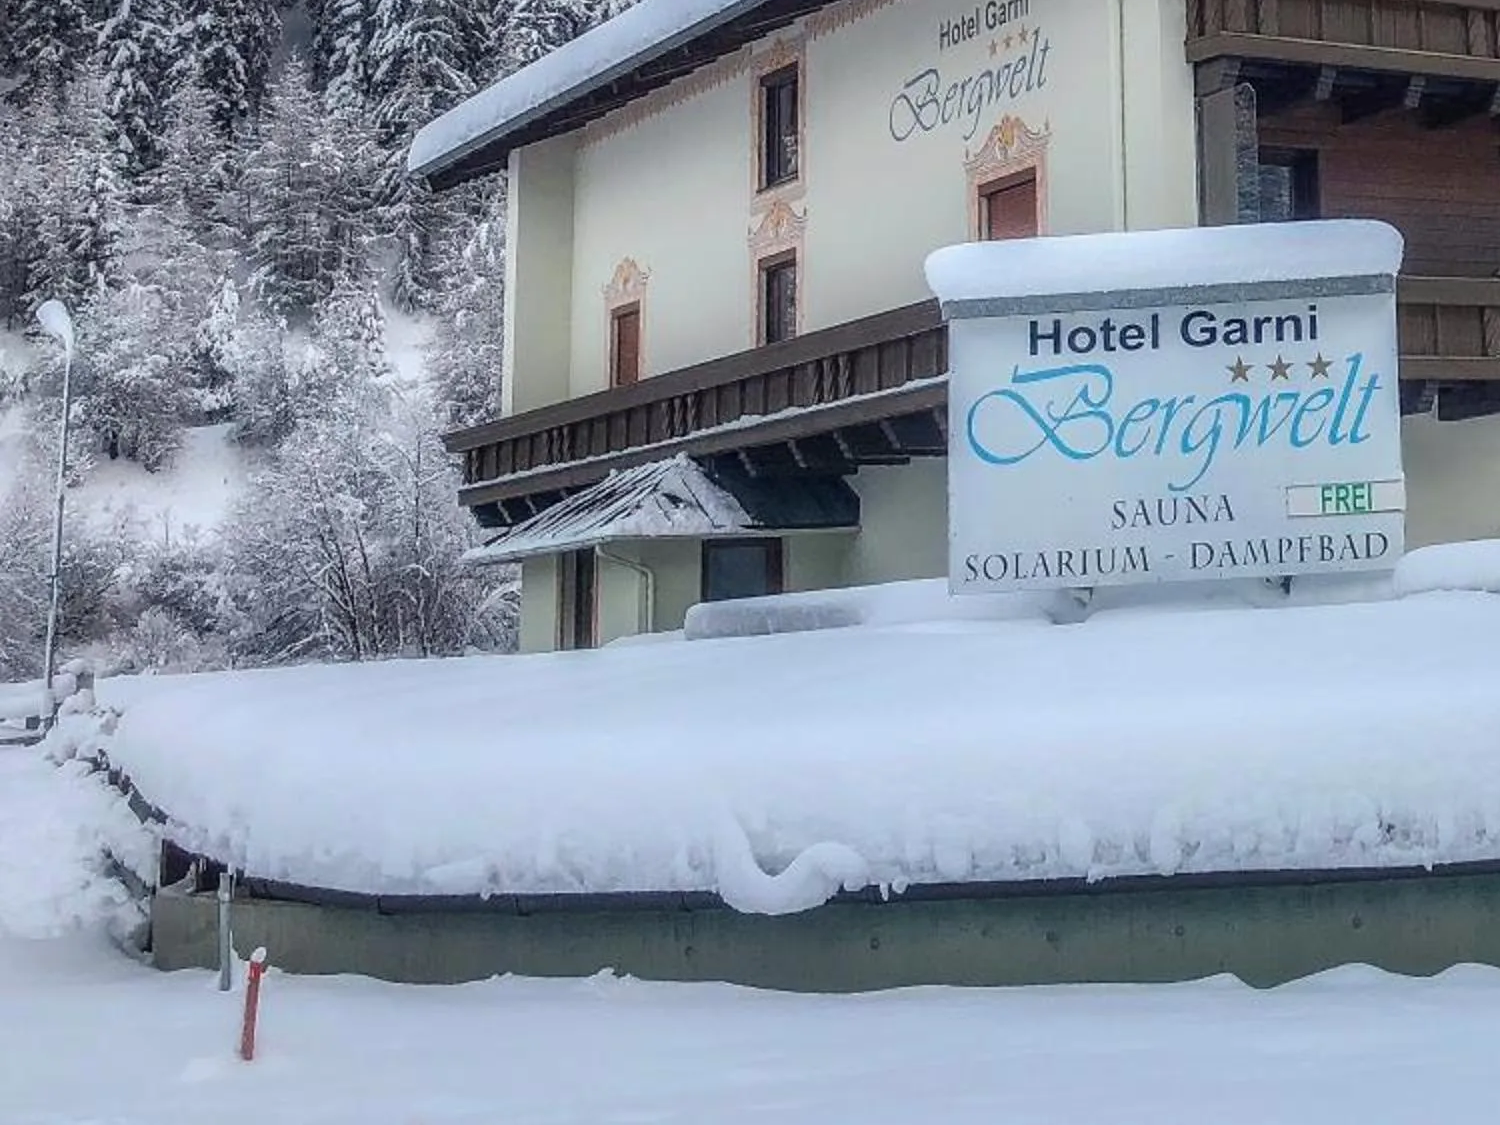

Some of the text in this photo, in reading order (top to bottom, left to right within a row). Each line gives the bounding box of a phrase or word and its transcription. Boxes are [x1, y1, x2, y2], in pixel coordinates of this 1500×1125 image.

[939, 7, 979, 51] Hotel
[889, 26, 1051, 142] Bergwelt
[1028, 304, 1318, 356] Hotel Garni
[966, 352, 1383, 492] Bergwelt
[1110, 493, 1236, 531] SAUNA
[1320, 483, 1373, 514] FREI
[964, 545, 1151, 582] SOLARIUM
[1189, 531, 1390, 571] DAMPFBAD
